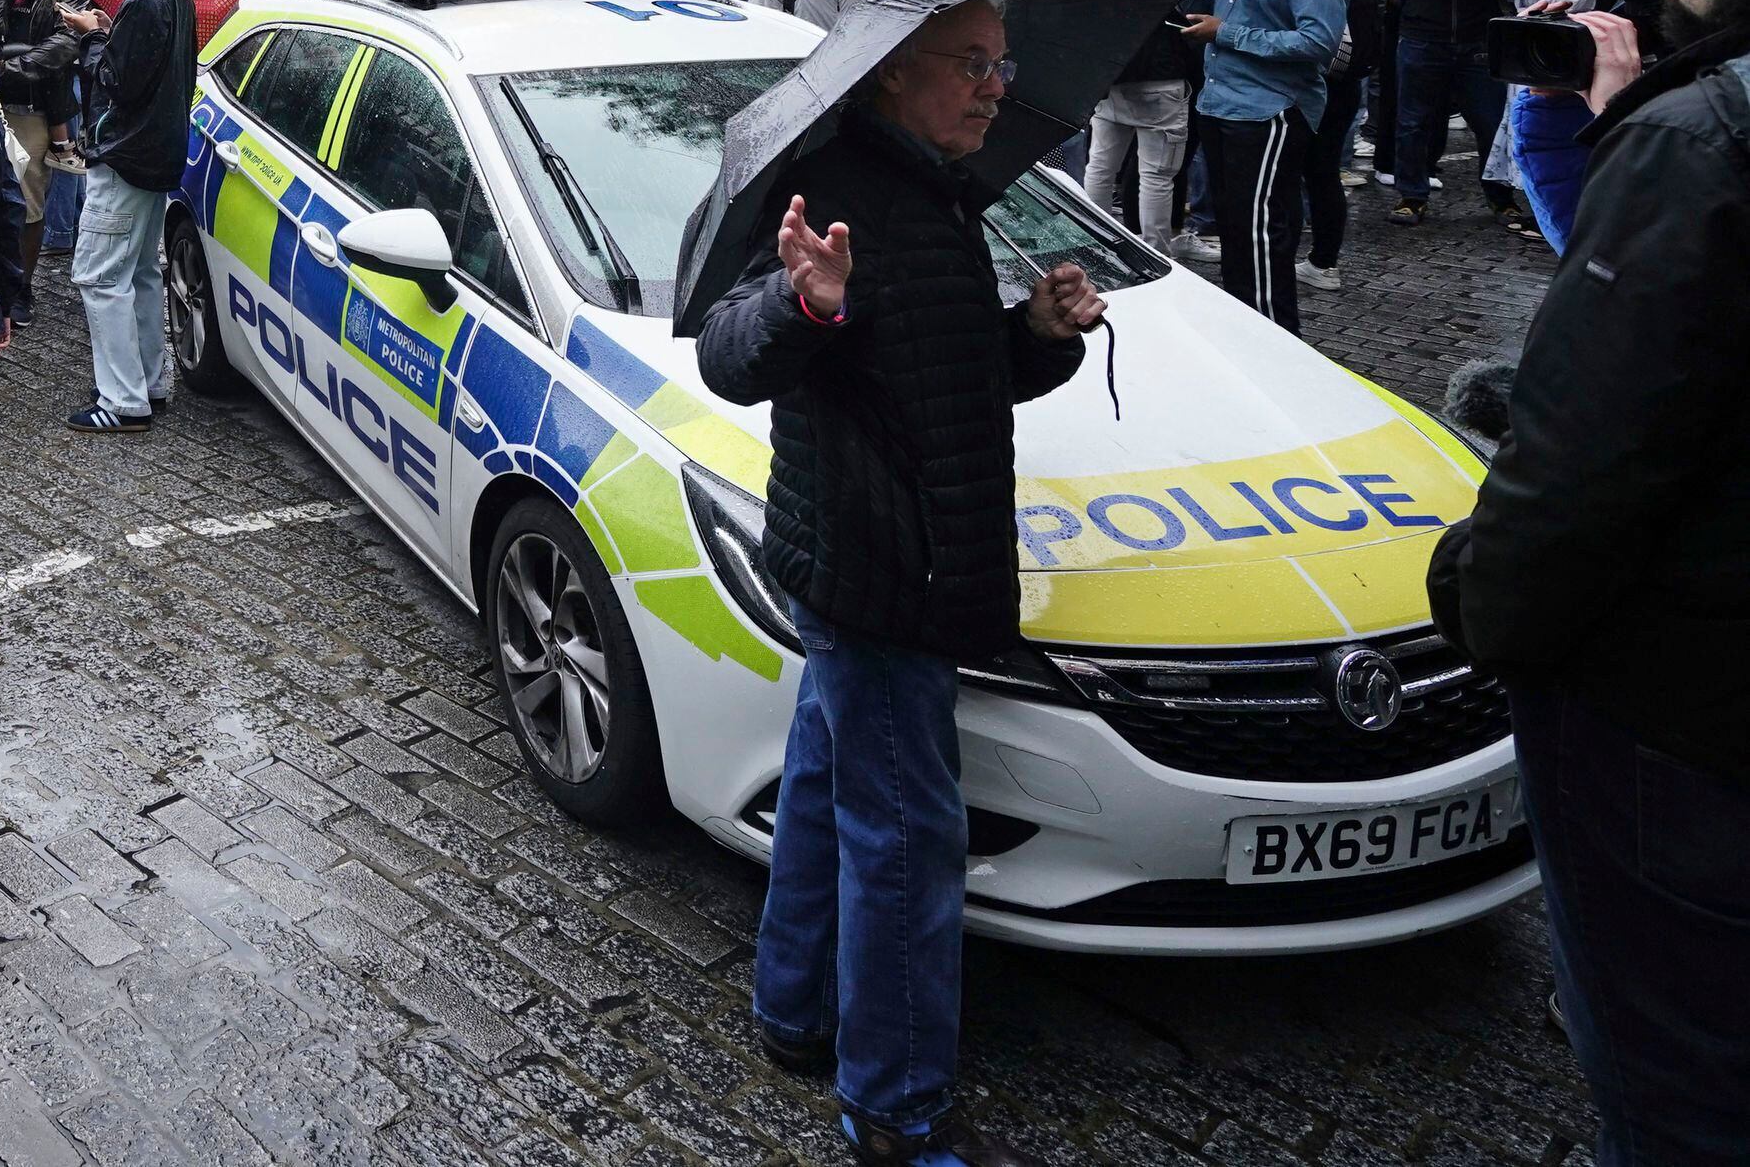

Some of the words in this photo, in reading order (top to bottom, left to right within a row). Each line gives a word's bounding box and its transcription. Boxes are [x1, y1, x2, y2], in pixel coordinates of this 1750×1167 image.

[377, 317, 436, 370] METROPOLITAN
[381, 343, 425, 388] POLICE
[228, 272, 441, 516] POLICE
[1016, 473, 1448, 567] POLICE
[1252, 815, 1398, 876] BX69
[1410, 793, 1492, 859] FGA
